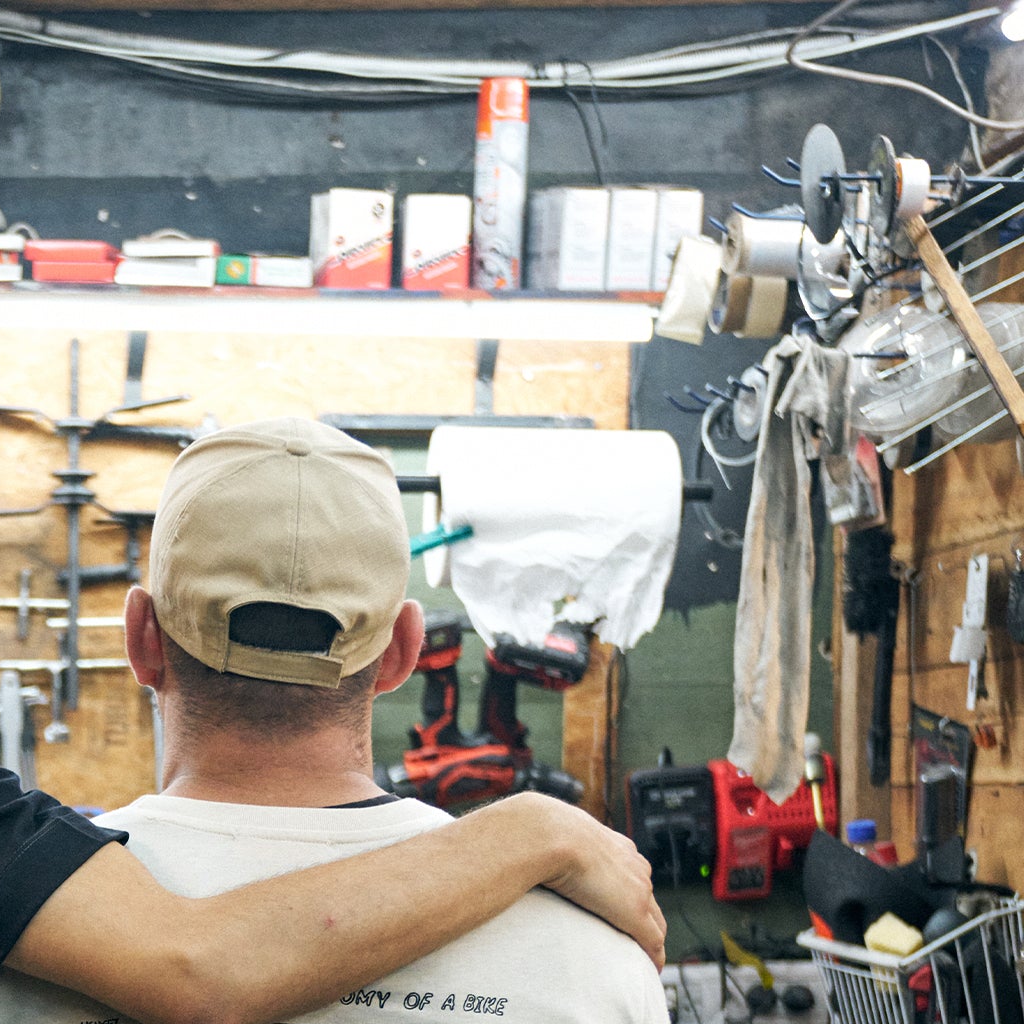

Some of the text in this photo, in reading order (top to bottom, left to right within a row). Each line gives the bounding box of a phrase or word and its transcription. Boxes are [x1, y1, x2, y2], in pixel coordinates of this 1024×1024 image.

[403, 992, 434, 1011] OF
[441, 993, 456, 1011] A
[462, 993, 508, 1016] BIKE
